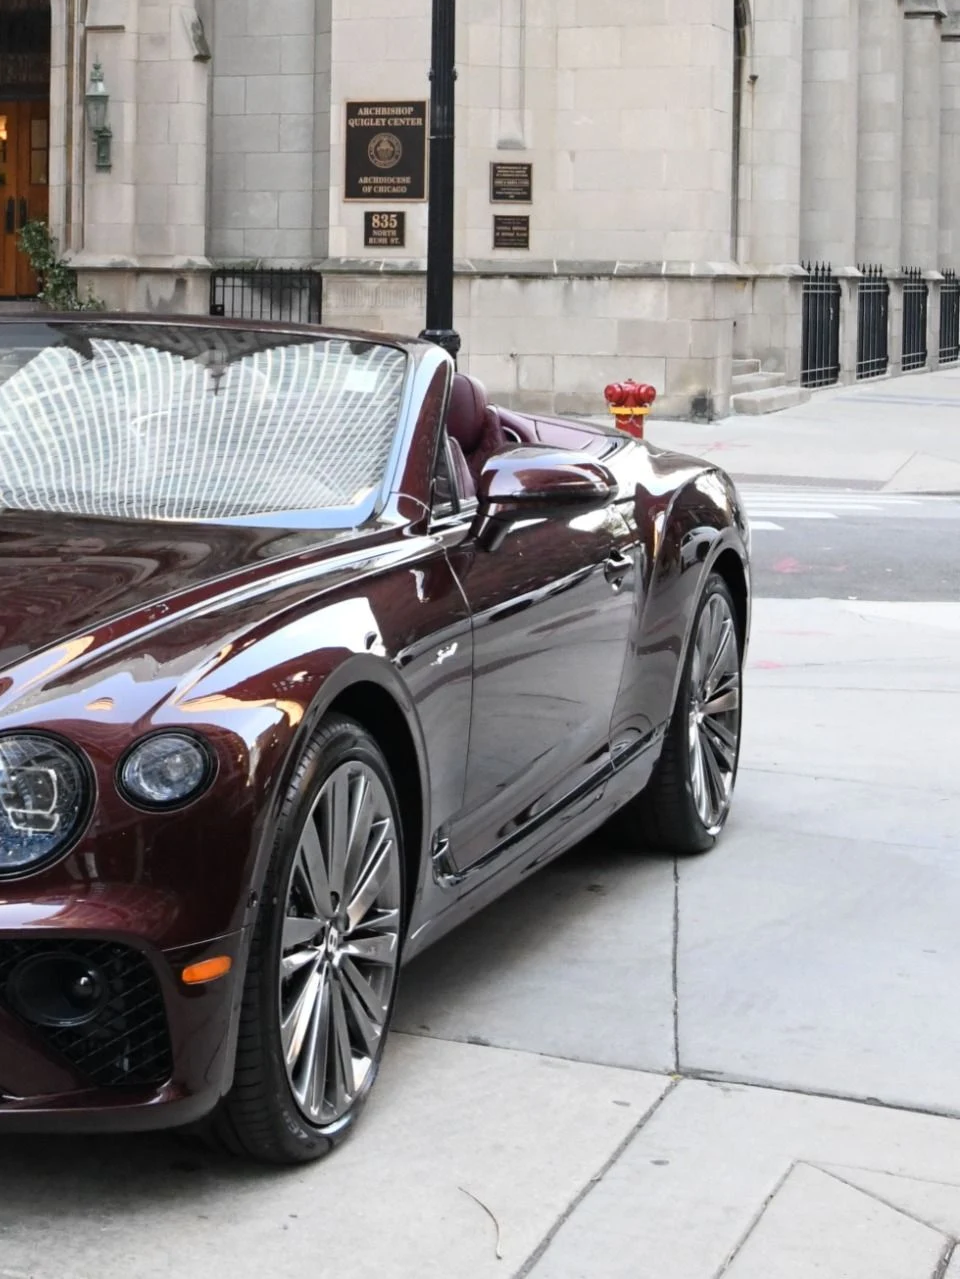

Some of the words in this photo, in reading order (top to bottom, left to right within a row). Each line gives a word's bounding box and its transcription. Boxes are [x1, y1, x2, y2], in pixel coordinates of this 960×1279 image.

[357, 107, 414, 116] ARCHBISHOP
[348, 118, 386, 127] QUIGLEY
[387, 118, 423, 126] CENTER
[358, 176, 411, 184] ARCHDIOCESE
[362, 185, 373, 194] OF
[373, 185, 408, 194] CHICAGO
[371, 214, 398, 229] 835
[372, 229, 397, 237] NORTH
